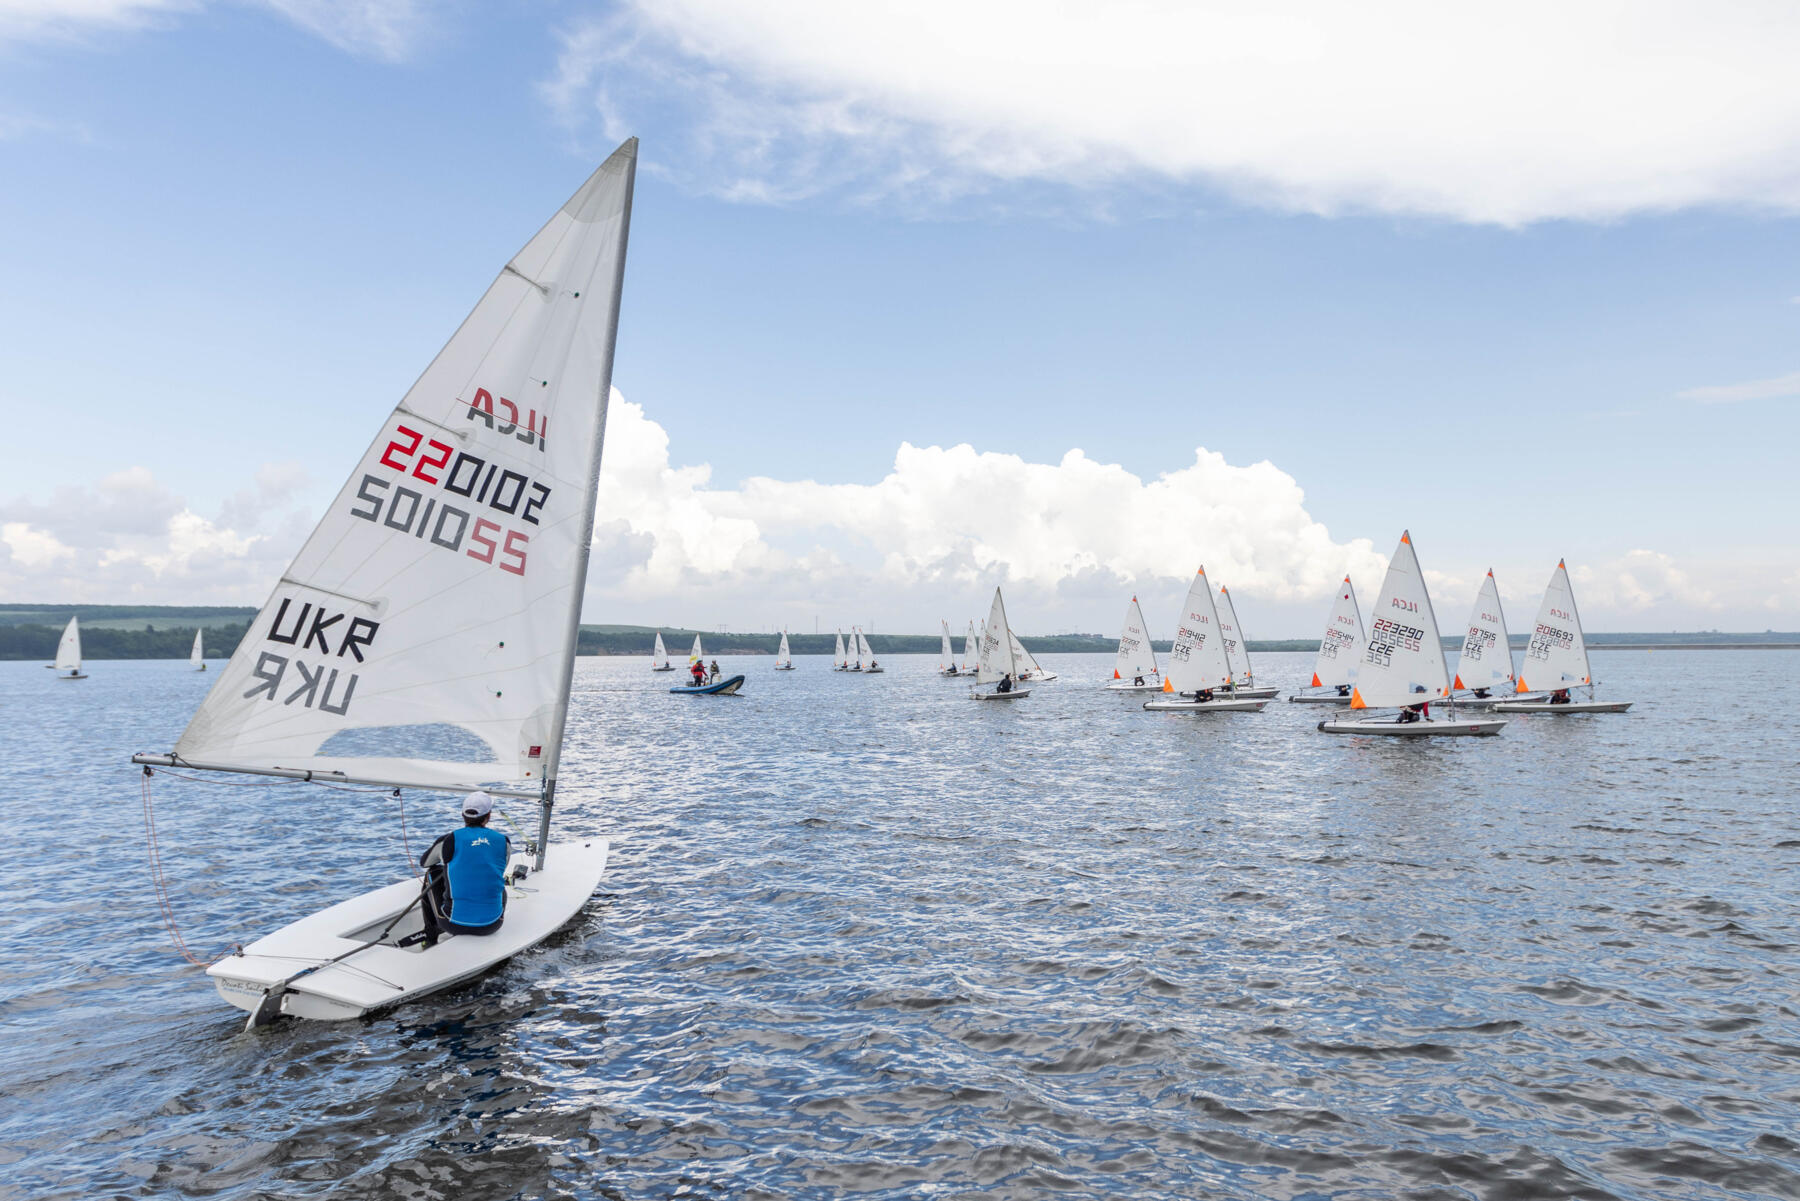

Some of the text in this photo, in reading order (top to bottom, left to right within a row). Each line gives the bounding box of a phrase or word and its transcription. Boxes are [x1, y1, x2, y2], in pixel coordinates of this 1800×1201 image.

[379, 425, 552, 526] 220102
[267, 598, 380, 663] UKR
[1178, 628, 1206, 642] 219412
[1374, 618, 1424, 640] 223290
[1536, 624, 1574, 641] 208693
[1175, 643, 1191, 655] CZE
[1323, 641, 1340, 651] CZE
[1368, 640, 1395, 656] CZE
[1466, 641, 1483, 653] CZE
[1531, 640, 1551, 653] CZE
